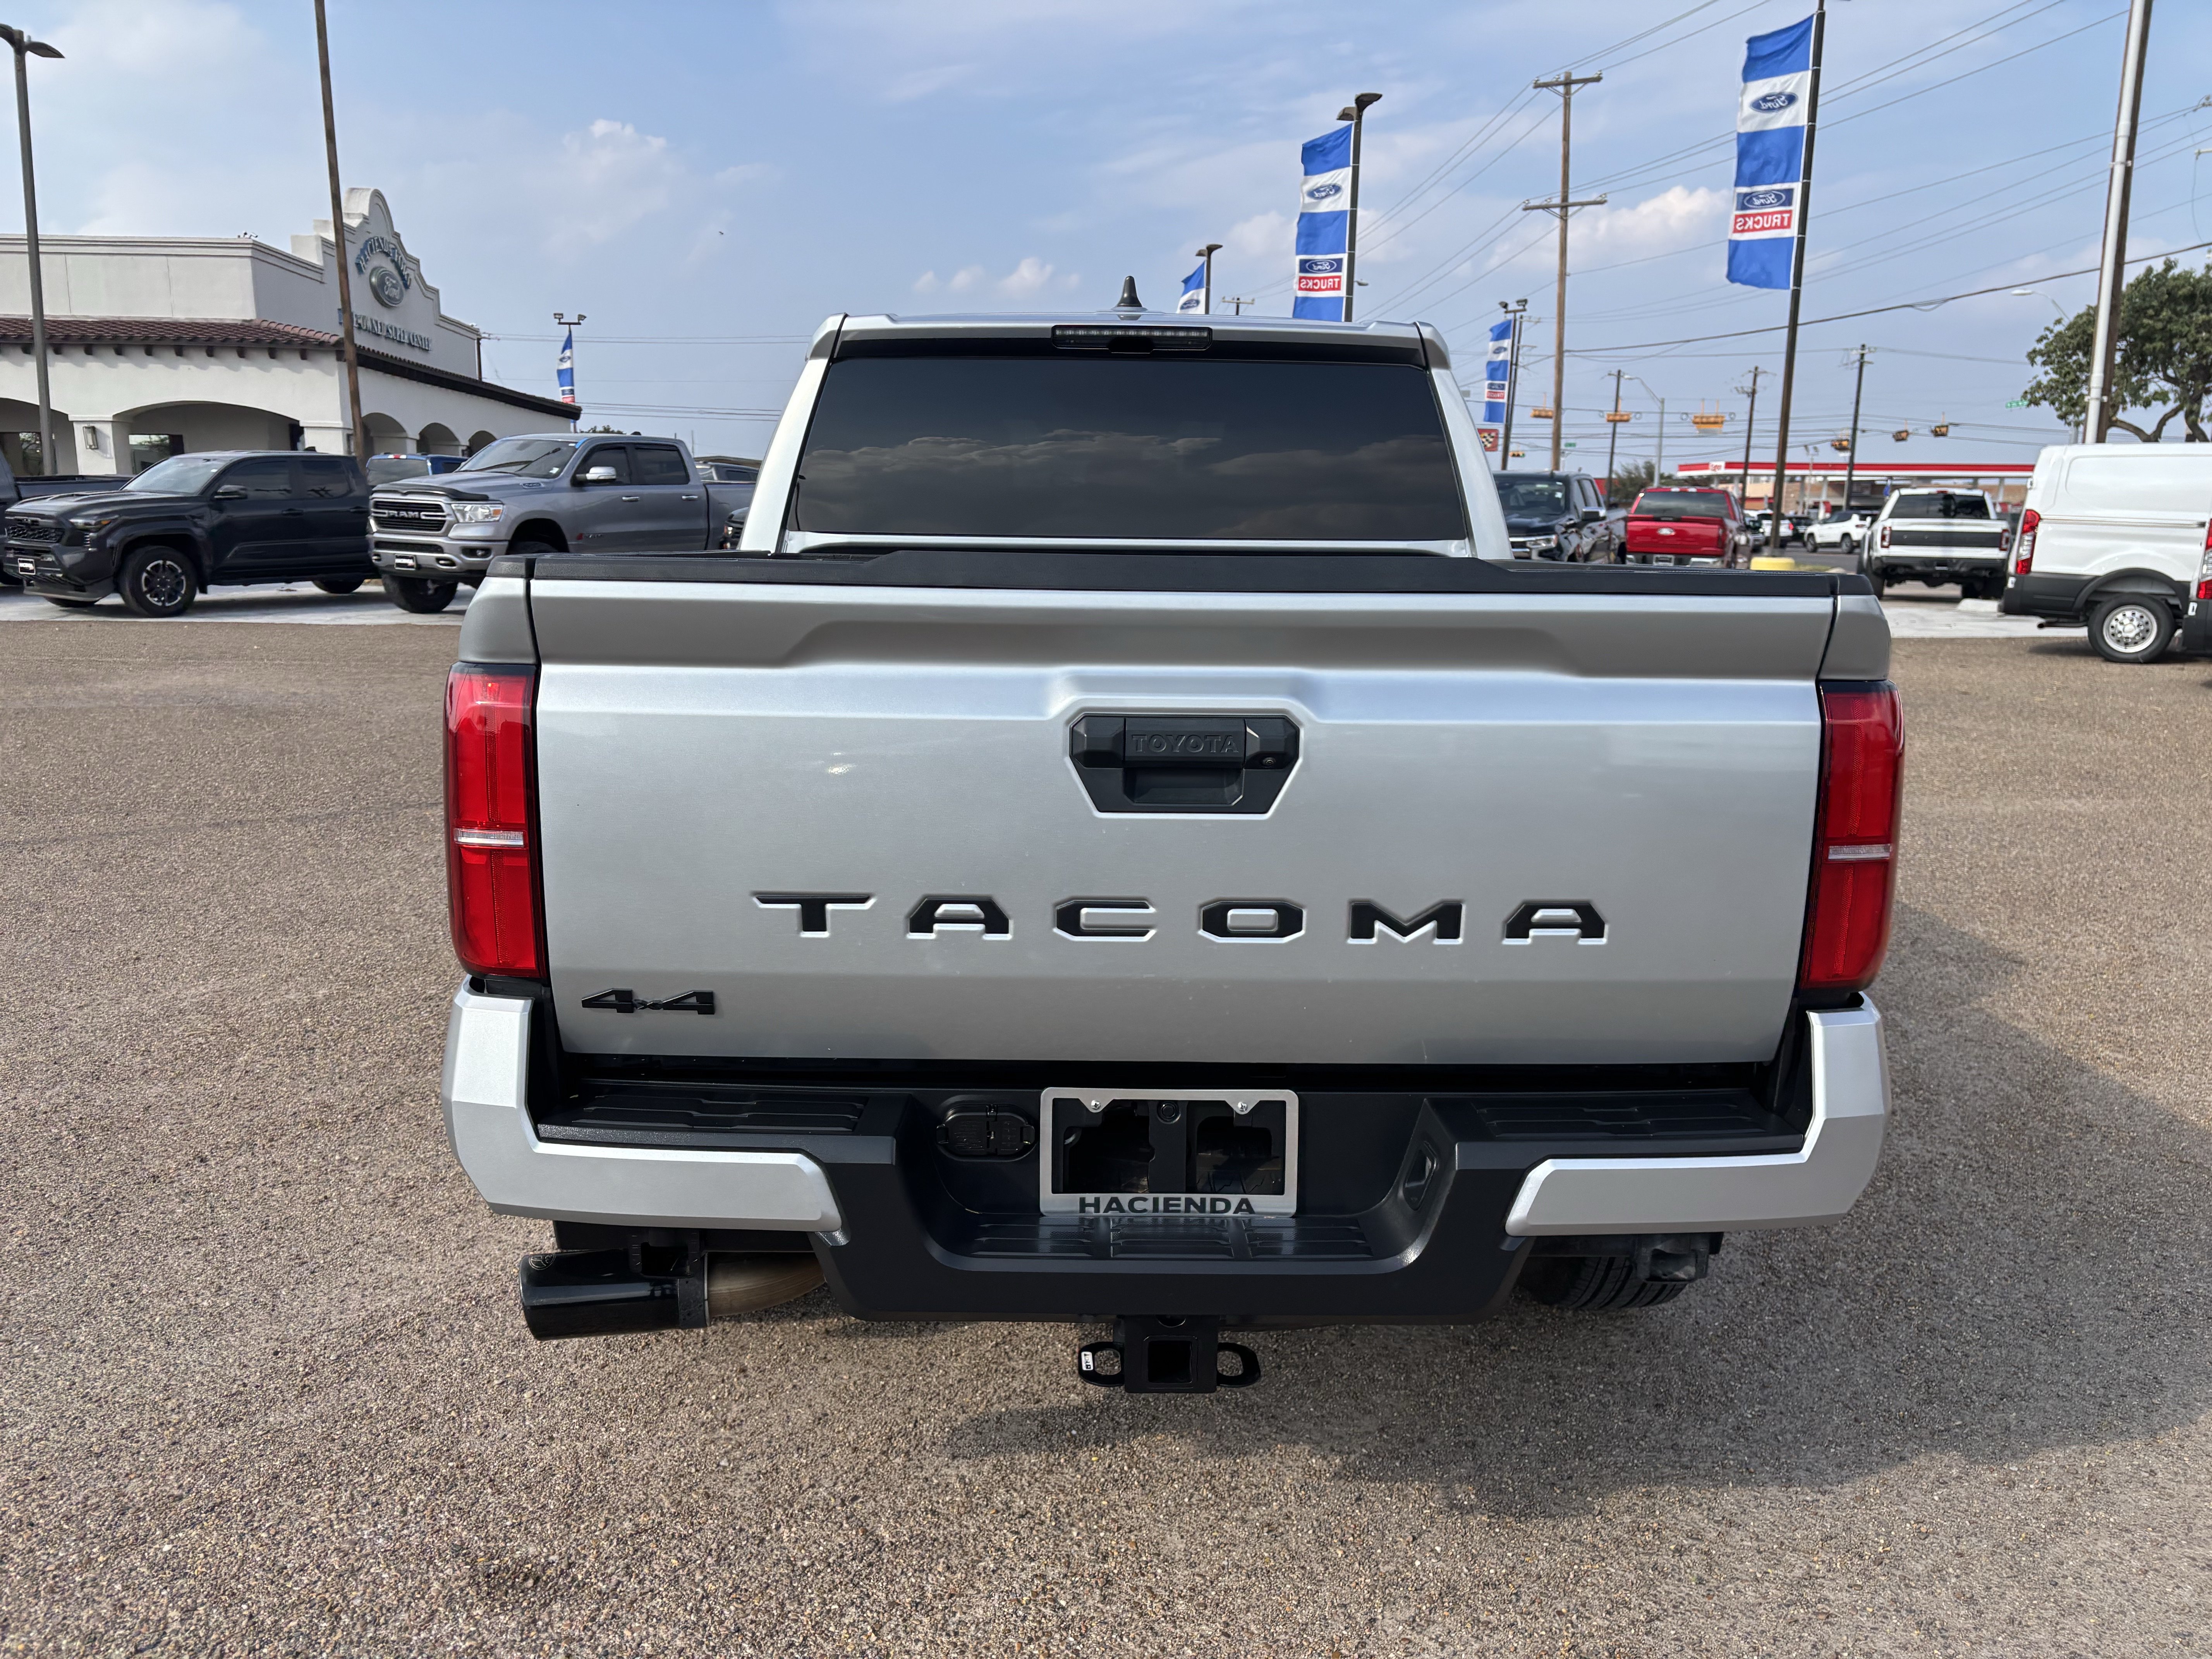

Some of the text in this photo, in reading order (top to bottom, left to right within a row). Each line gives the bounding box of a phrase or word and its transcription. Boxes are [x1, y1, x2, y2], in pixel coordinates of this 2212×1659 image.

[388, 510, 419, 519] RAM
[1131, 734, 1239, 754] TOYOTA
[754, 894, 1608, 945] TACOMA
[1079, 1196, 1255, 1215] HACIENDA
